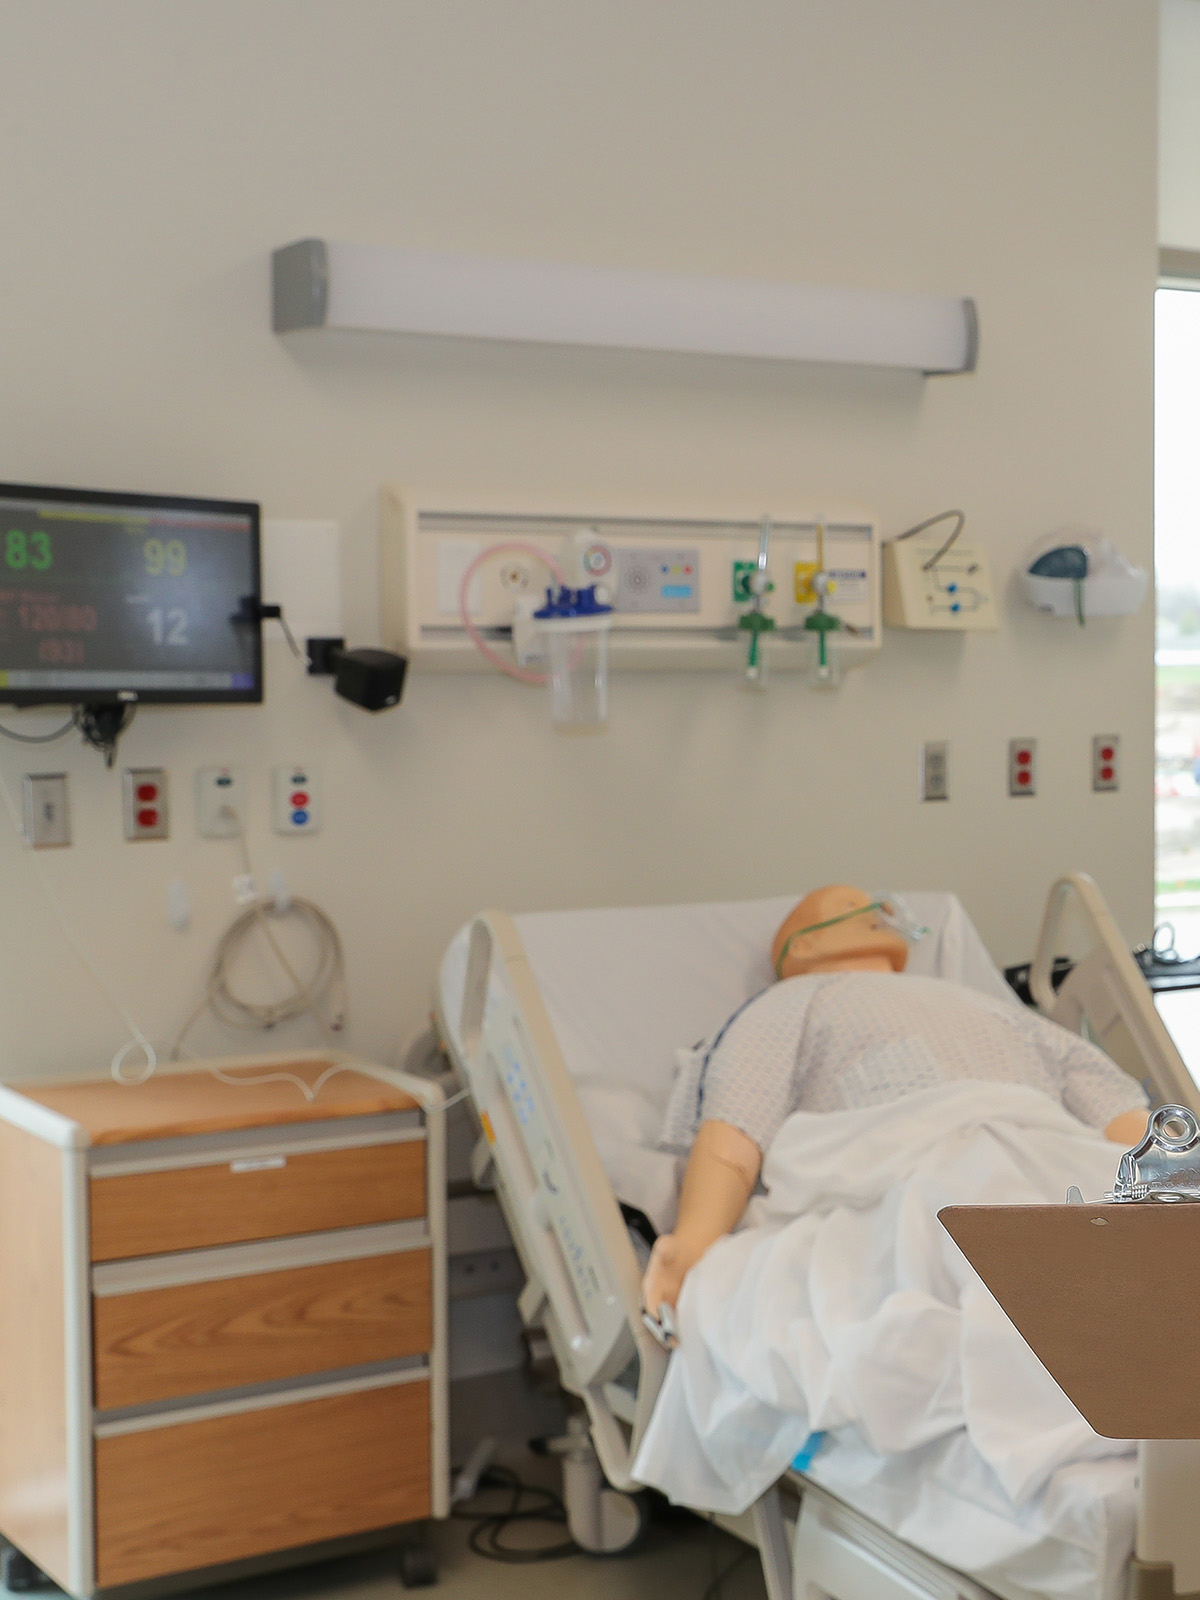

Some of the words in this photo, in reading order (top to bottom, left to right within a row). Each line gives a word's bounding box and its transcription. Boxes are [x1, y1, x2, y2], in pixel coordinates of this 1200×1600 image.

[5, 529, 53, 570] 83
[143, 538, 188, 577] 99
[147, 608, 189, 646] 12
